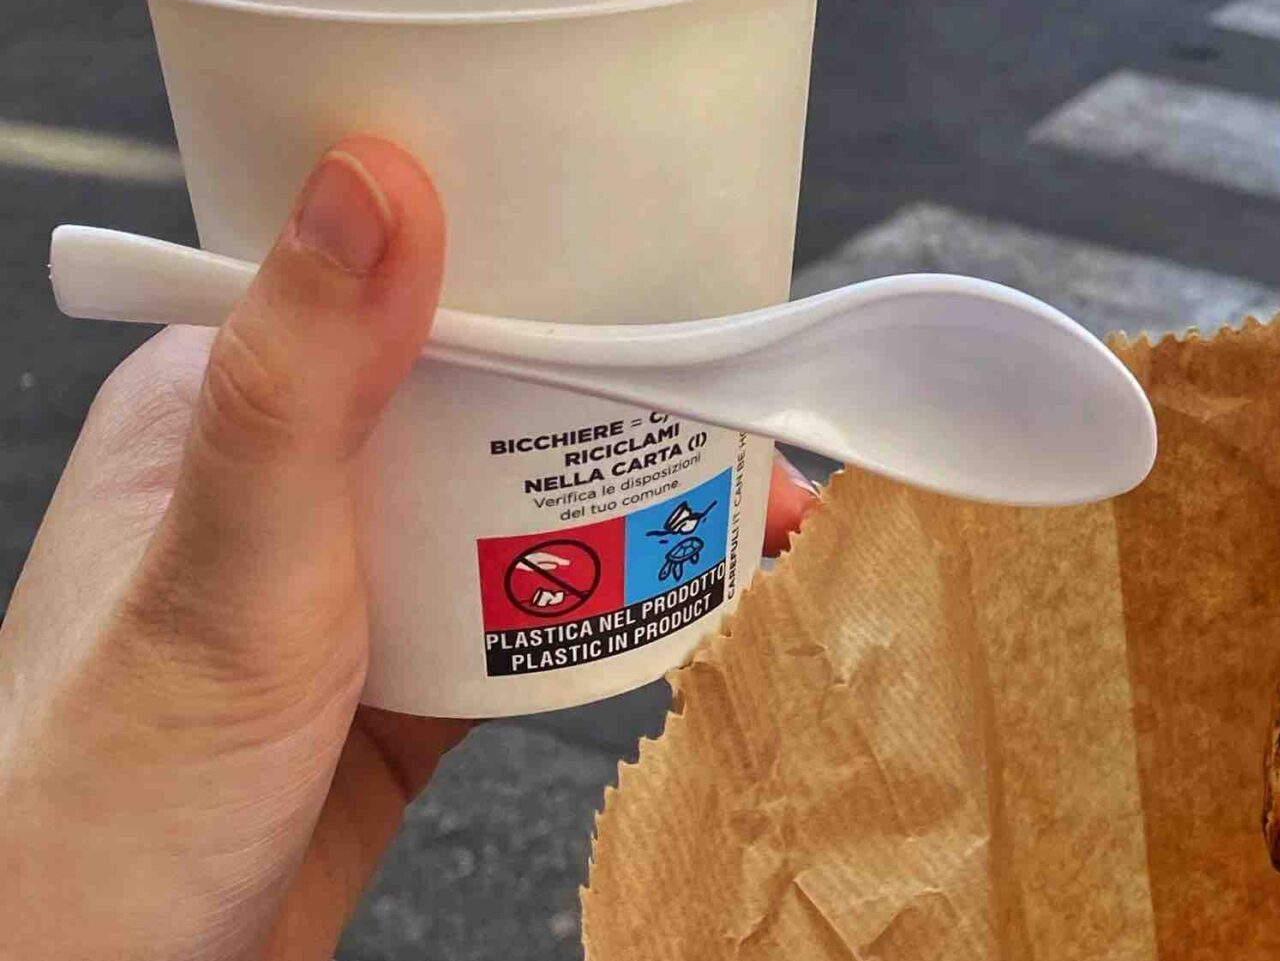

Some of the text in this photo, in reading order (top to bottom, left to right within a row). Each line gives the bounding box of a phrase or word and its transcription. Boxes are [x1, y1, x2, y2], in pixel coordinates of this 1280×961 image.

[490, 420, 624, 455] BICCHIERE
[565, 423, 679, 467] RICICLAMI
[524, 470, 605, 494] NELLA
[611, 443, 683, 477] CARTA
[533, 452, 702, 509] Verifica le disposizioni
[737, 450, 745, 471] BE
[559, 505, 585, 521] del
[590, 500, 617, 514] tuo
[734, 474, 743, 507] CAN
[732, 512, 740, 525] IT
[727, 528, 739, 600] CAREFUL!
[486, 562, 725, 651] PLASTICA NEL PRODOTTO
[511, 593, 713, 672] PLASTIC IN PRODUCT
